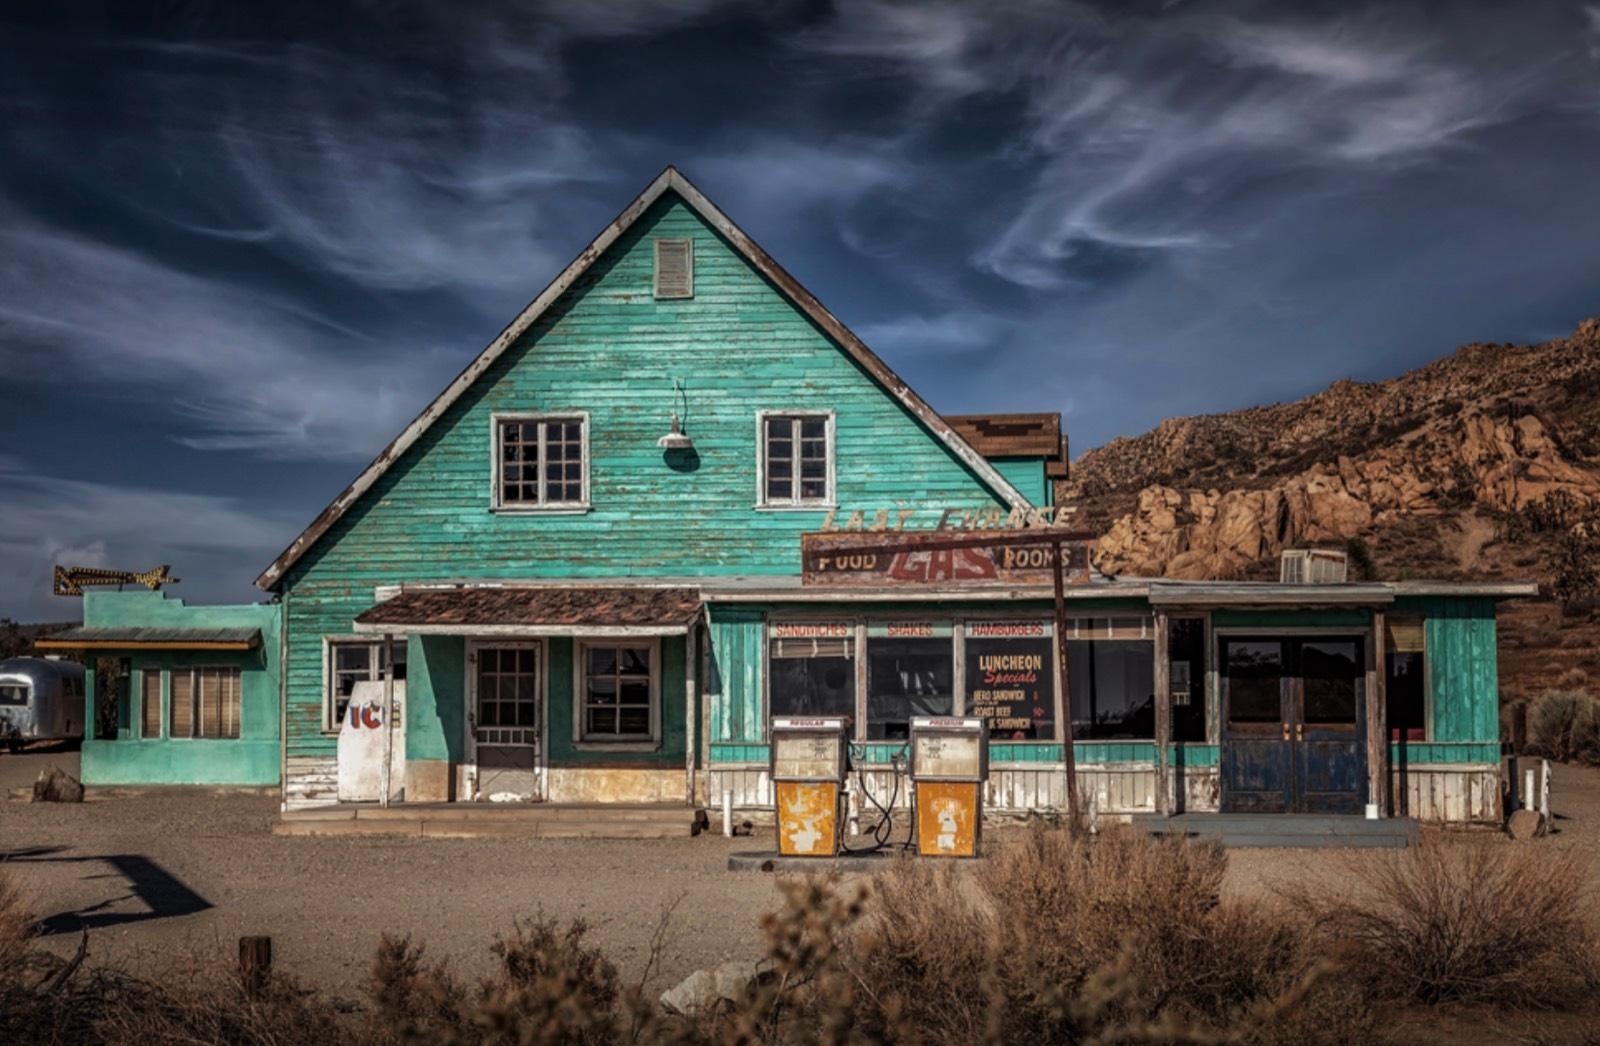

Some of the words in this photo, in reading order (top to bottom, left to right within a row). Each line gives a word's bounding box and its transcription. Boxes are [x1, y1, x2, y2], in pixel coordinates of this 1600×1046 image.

[887, 533, 999, 581] GAS
[1003, 547, 1071, 568] ROOMS
[776, 622, 848, 637] SANDWICHES
[887, 623, 933, 636] SHAKES
[972, 623, 1044, 636] HAMBURGERS
[980, 655, 1042, 670] LUNCHEON
[983, 669, 1037, 687] Specials
[790, 719, 825, 727] REGULAR
[929, 719, 965, 727] PREMIUM
